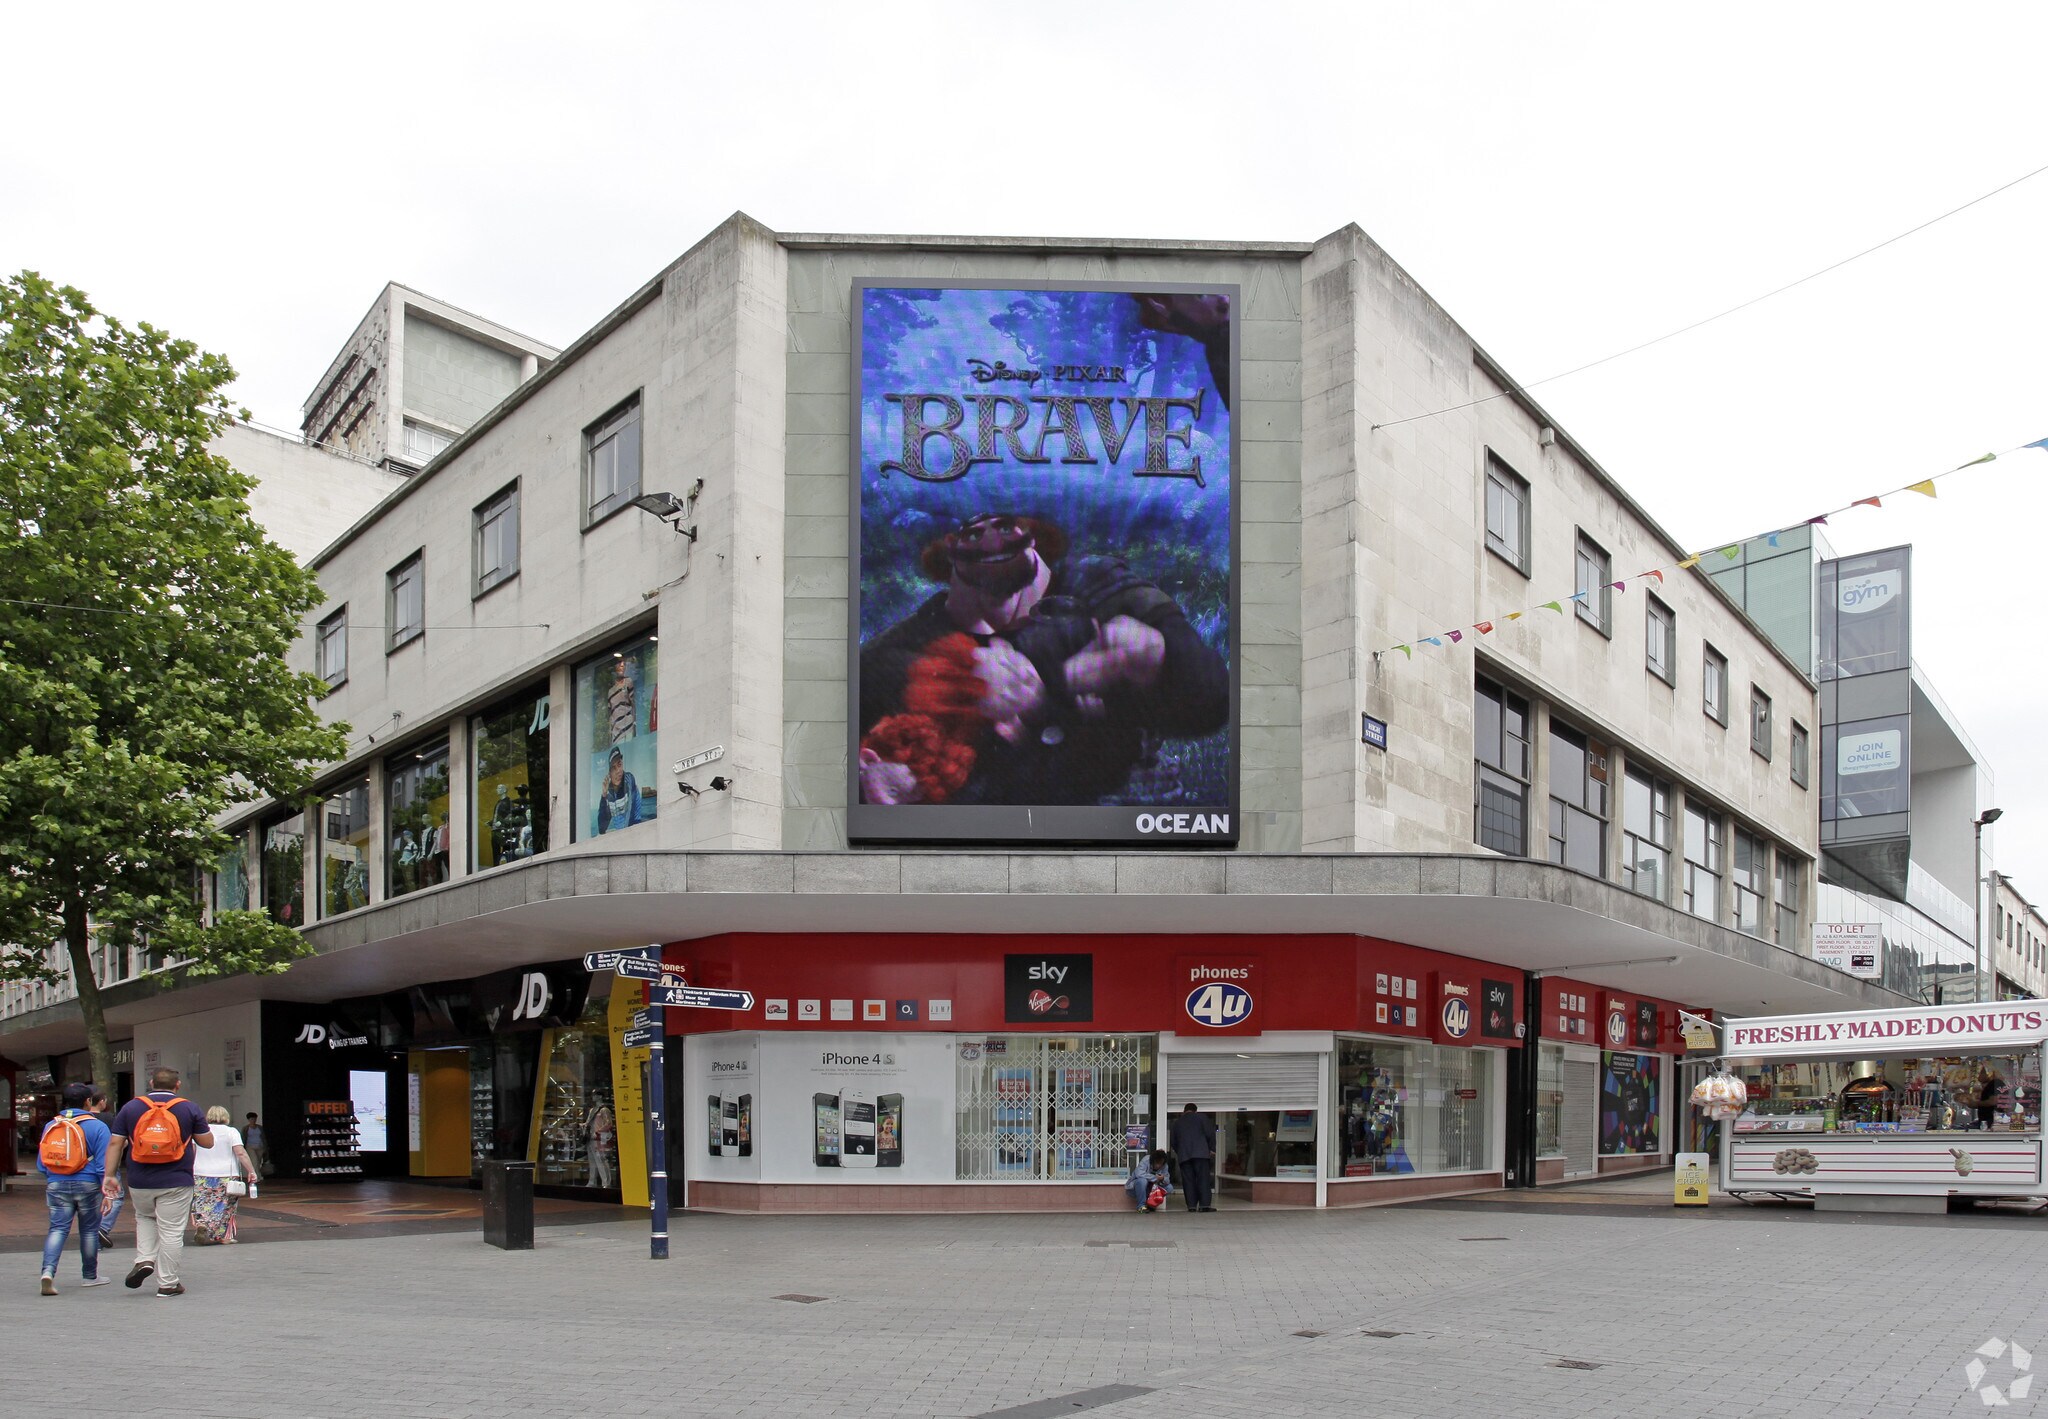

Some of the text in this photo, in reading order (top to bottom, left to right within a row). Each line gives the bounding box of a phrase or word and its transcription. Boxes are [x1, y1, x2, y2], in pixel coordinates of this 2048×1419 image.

[966, 358, 1127, 388] Disney PIXAR
[879, 387, 1207, 488] BRAVE
[1843, 583, 1888, 607] gym
[1847, 750, 1891, 763] ONLINE
[1856, 742, 1884, 752] JOIN
[681, 757, 696, 769] NEW
[1135, 813, 1230, 836] OCEAN
[1828, 925, 1865, 933] TO LET
[1028, 961, 1068, 983] sky
[1190, 964, 1249, 982] phones
[513, 972, 552, 1021] JD
[1444, 981, 1469, 996] phones
[1490, 987, 1505, 1006] sky
[1028, 993, 1052, 1012] Virgin
[1193, 986, 1247, 1024] 4u
[1447, 1001, 1468, 1035] 4u
[1641, 1006, 1651, 1022] sky
[294, 1024, 326, 1044] JD
[1611, 1014, 1626, 1041] 4u
[1734, 1011, 2042, 1045] FRESHLY MADE DONUTS
[712, 1061, 735, 1072] iPhone
[822, 1053, 869, 1065] iPhone
[309, 1102, 348, 1114] OFFER
